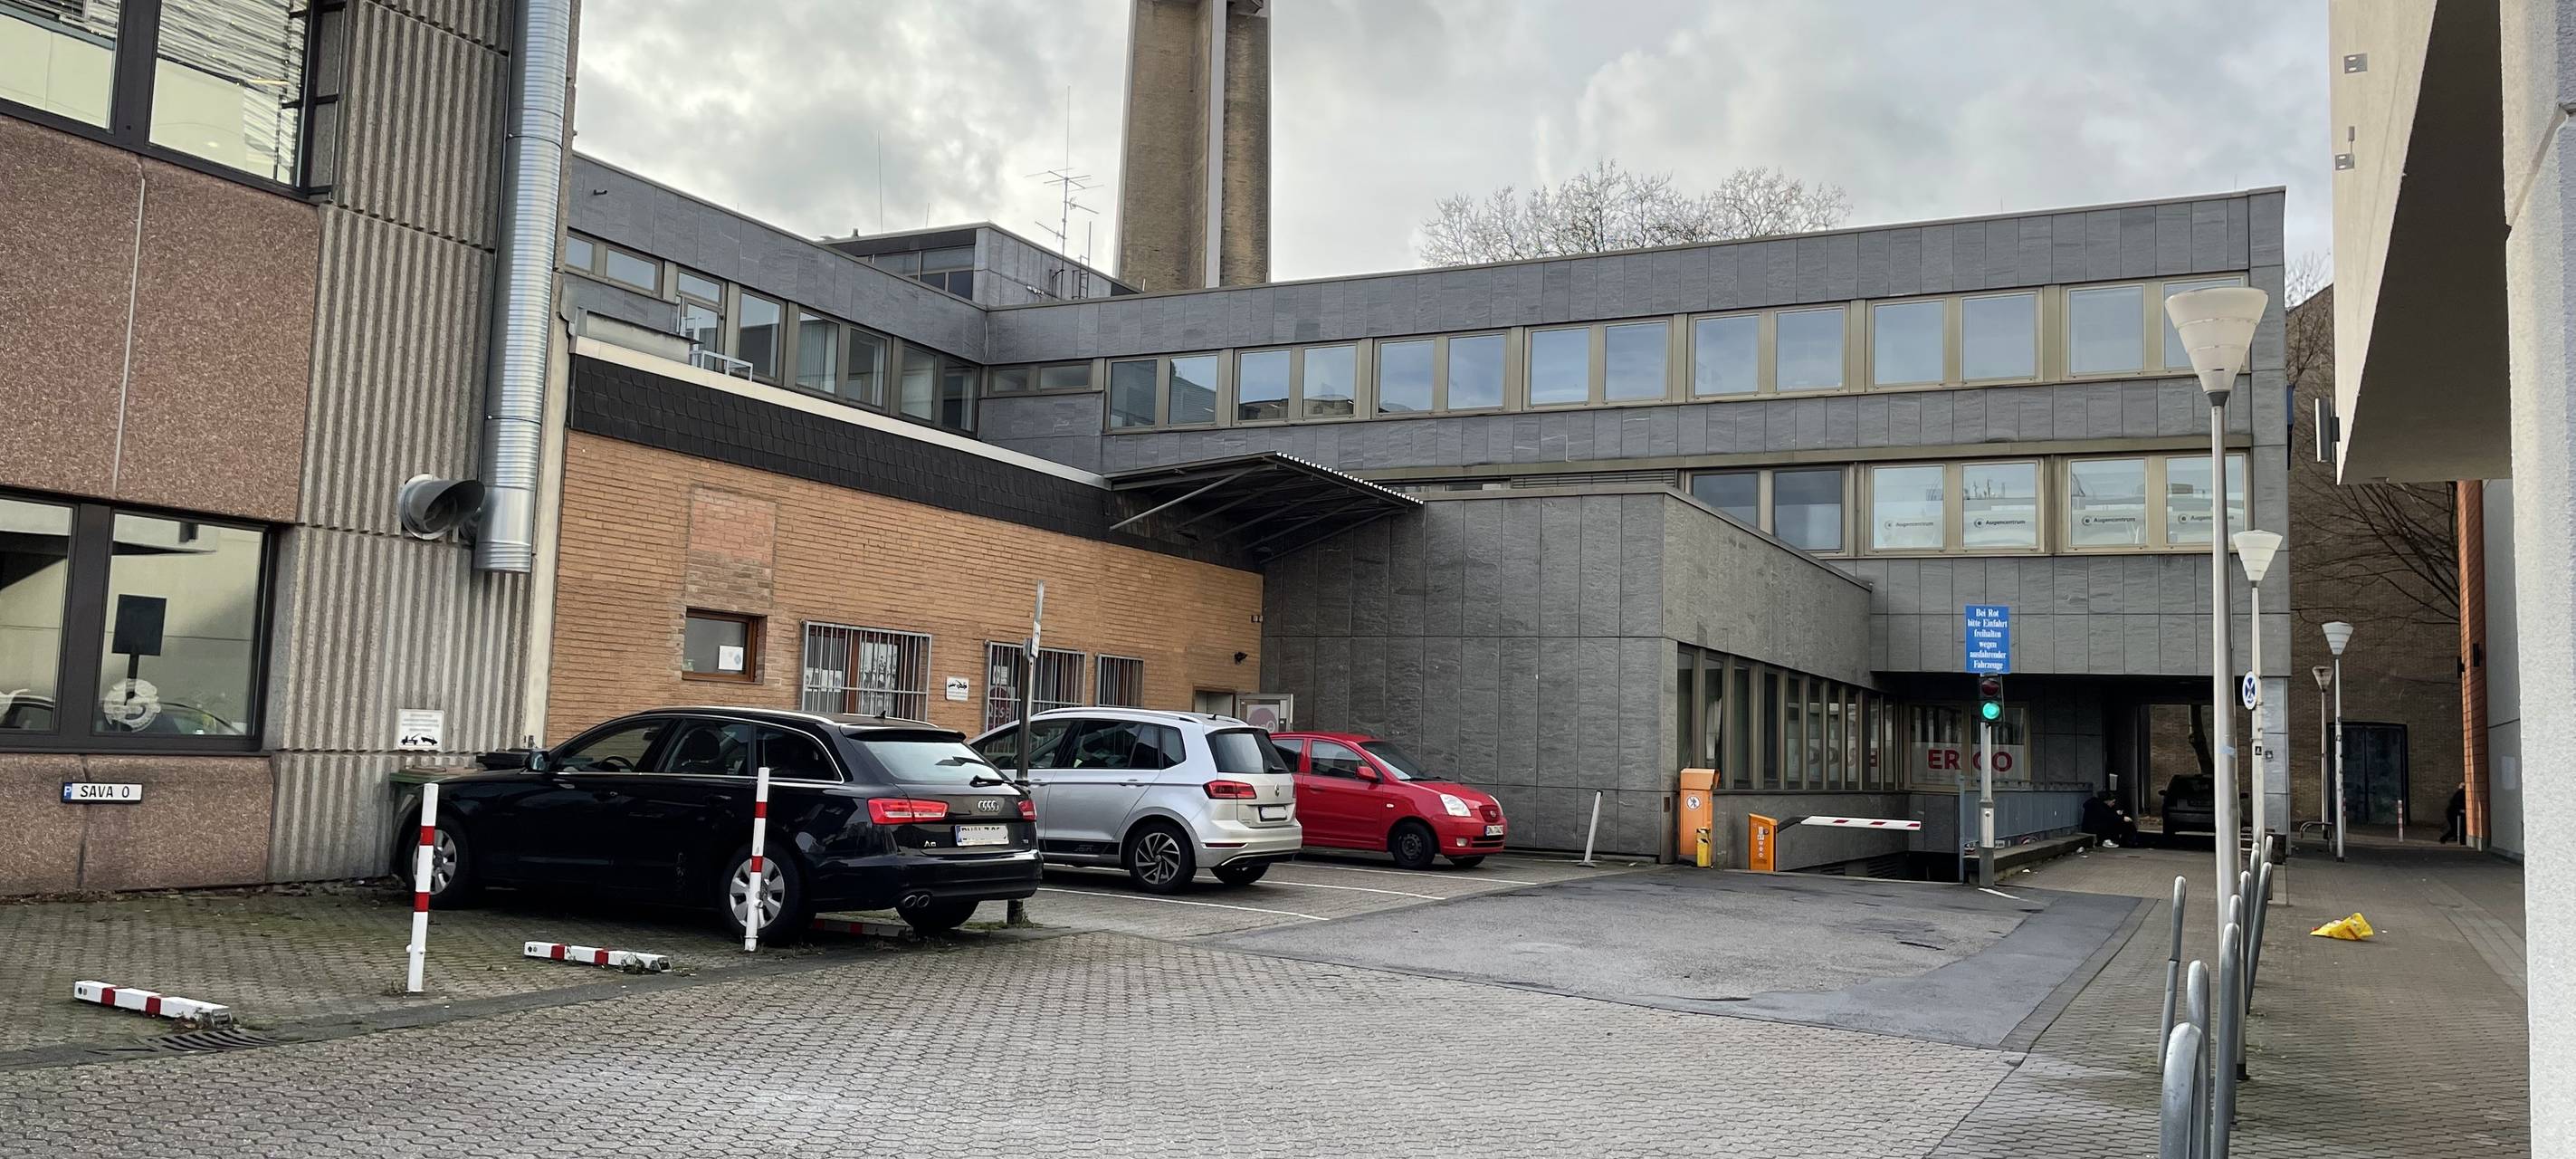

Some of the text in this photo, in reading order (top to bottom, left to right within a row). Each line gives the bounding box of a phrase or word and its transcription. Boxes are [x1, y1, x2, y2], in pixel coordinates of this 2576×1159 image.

[1976, 608, 1999, 618] Bei Rot
[1968, 618, 2008, 627] bitte Einfahrt
[1974, 628, 2002, 637] freihalten
[1979, 641, 1998, 649] wegen
[1973, 660, 2004, 670] Fahrzeuge
[80, 785, 114, 798] SAVA
